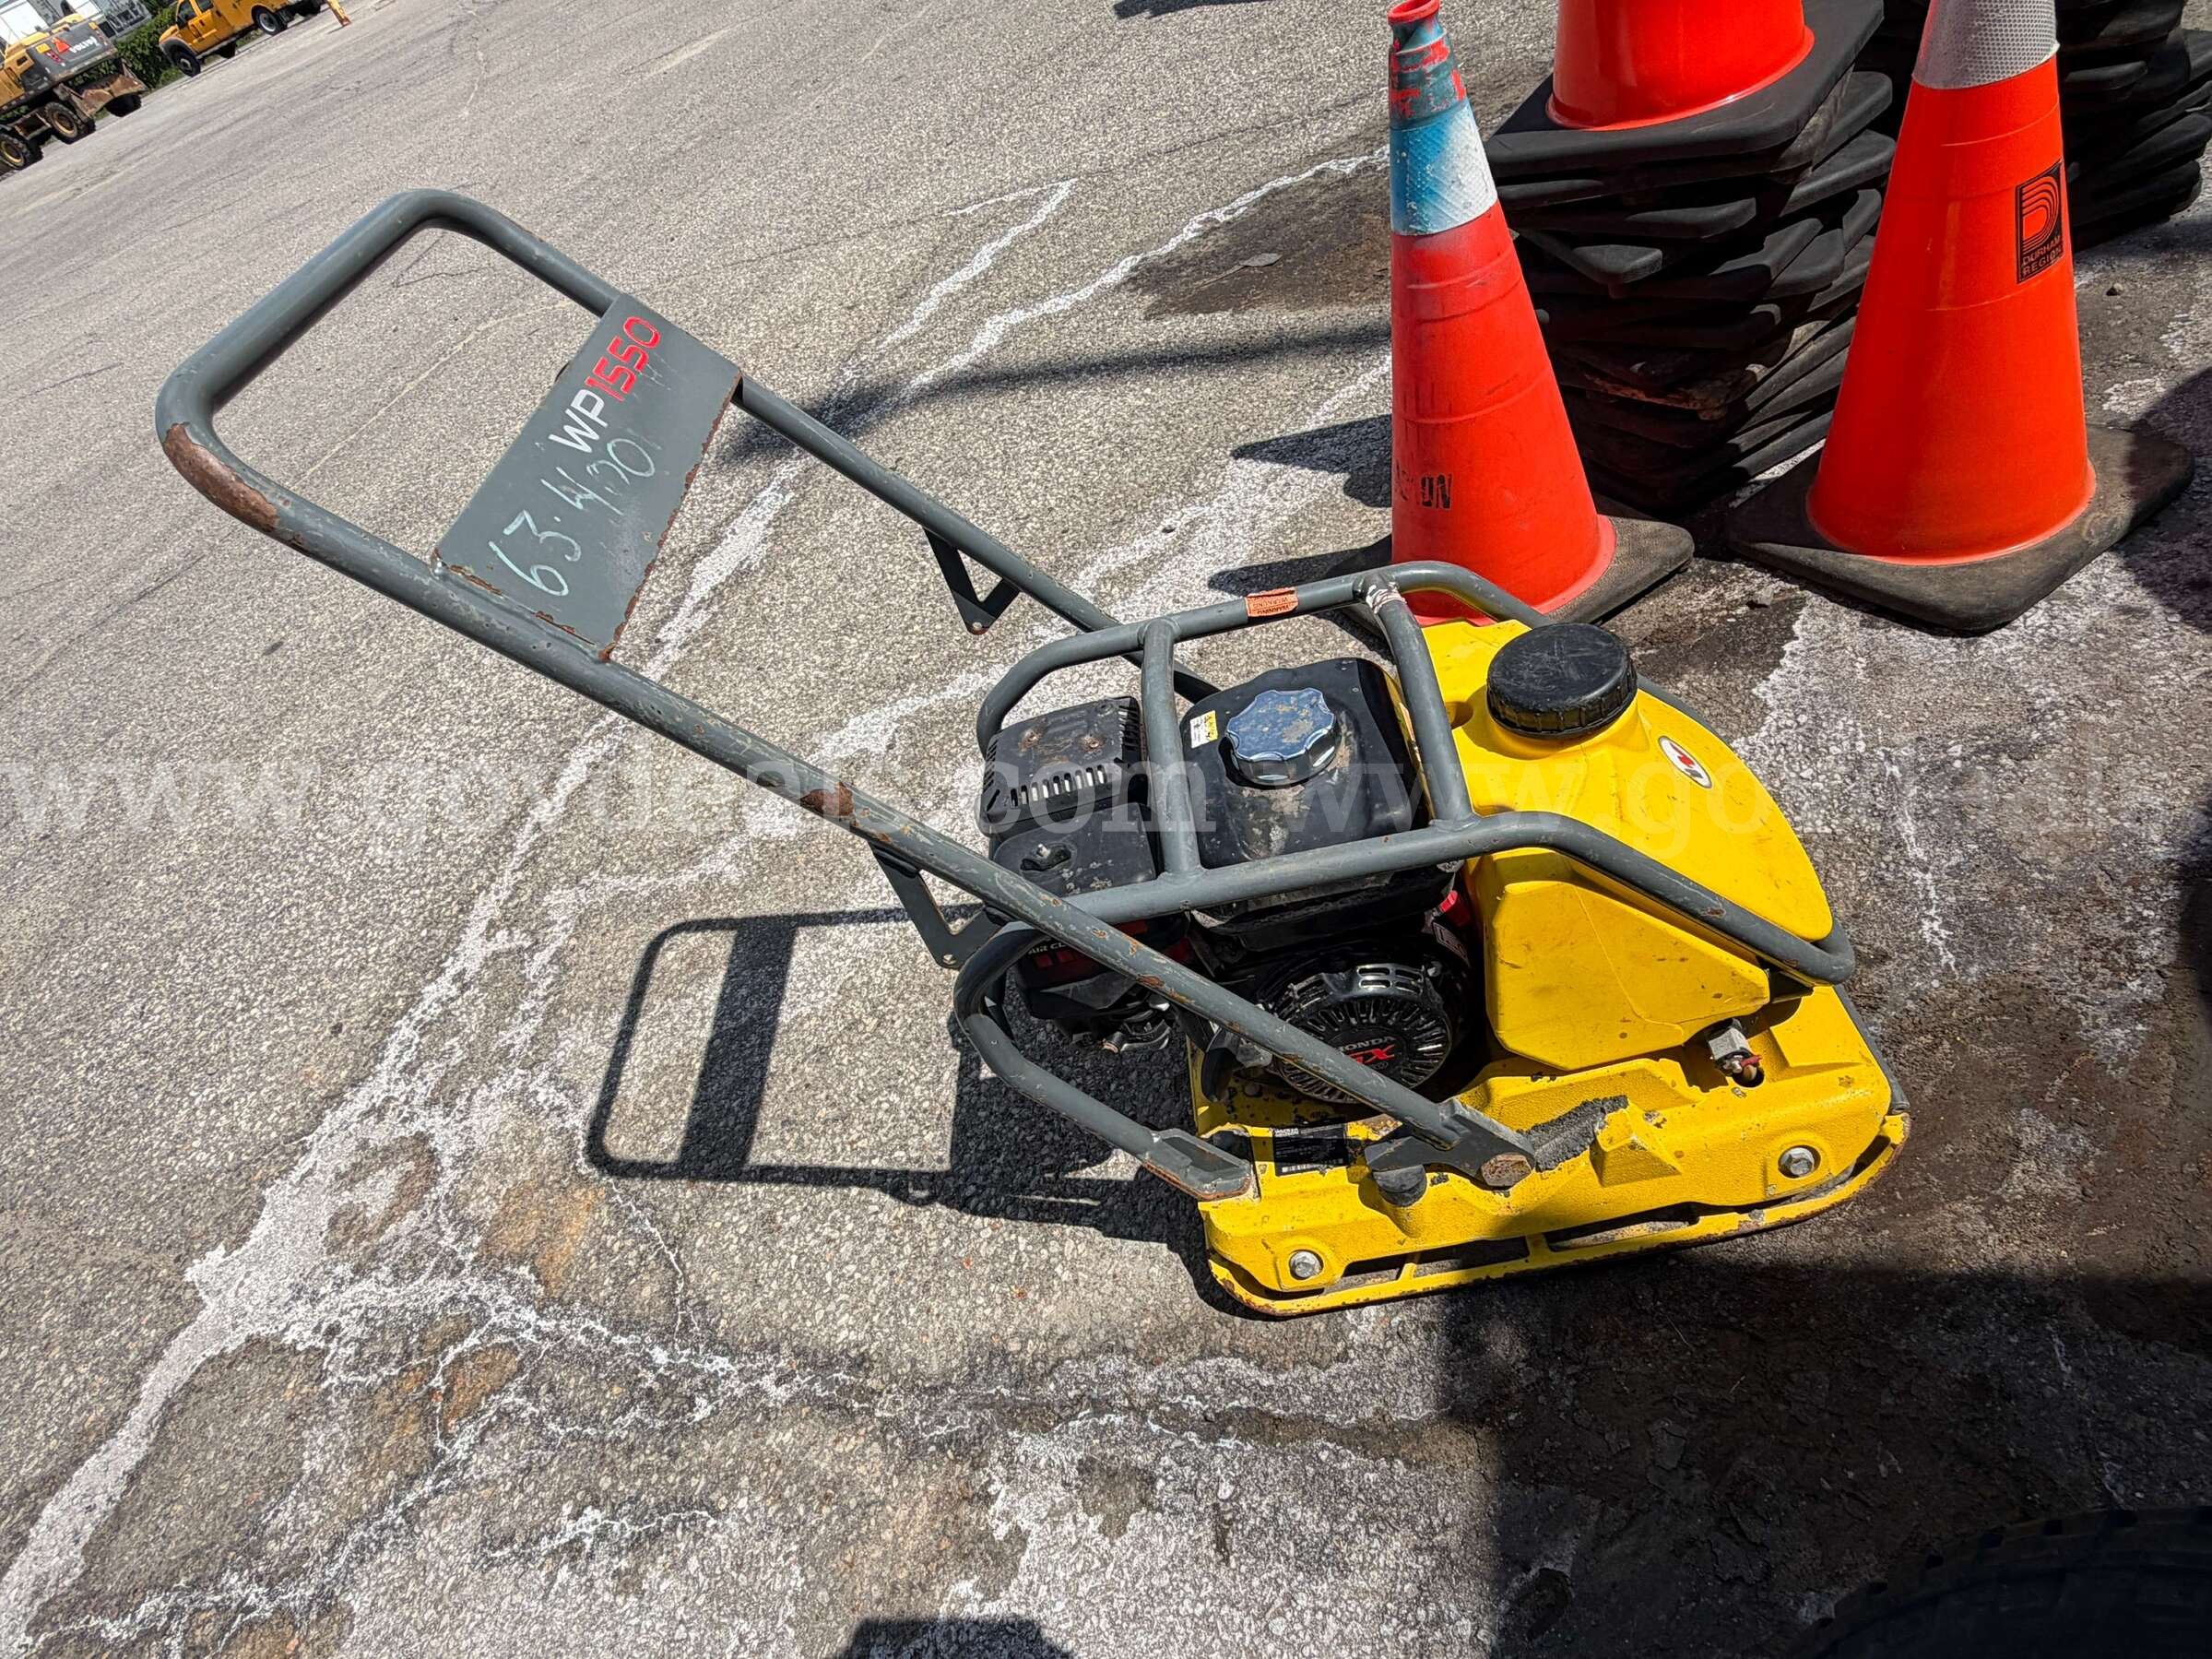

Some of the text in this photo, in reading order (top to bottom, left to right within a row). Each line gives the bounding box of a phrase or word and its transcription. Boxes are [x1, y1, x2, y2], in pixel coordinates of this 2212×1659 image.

[2021, 235, 2062, 267] DURHAM
[2022, 245, 2063, 277] REGION
[549, 315, 662, 454] WP1550
